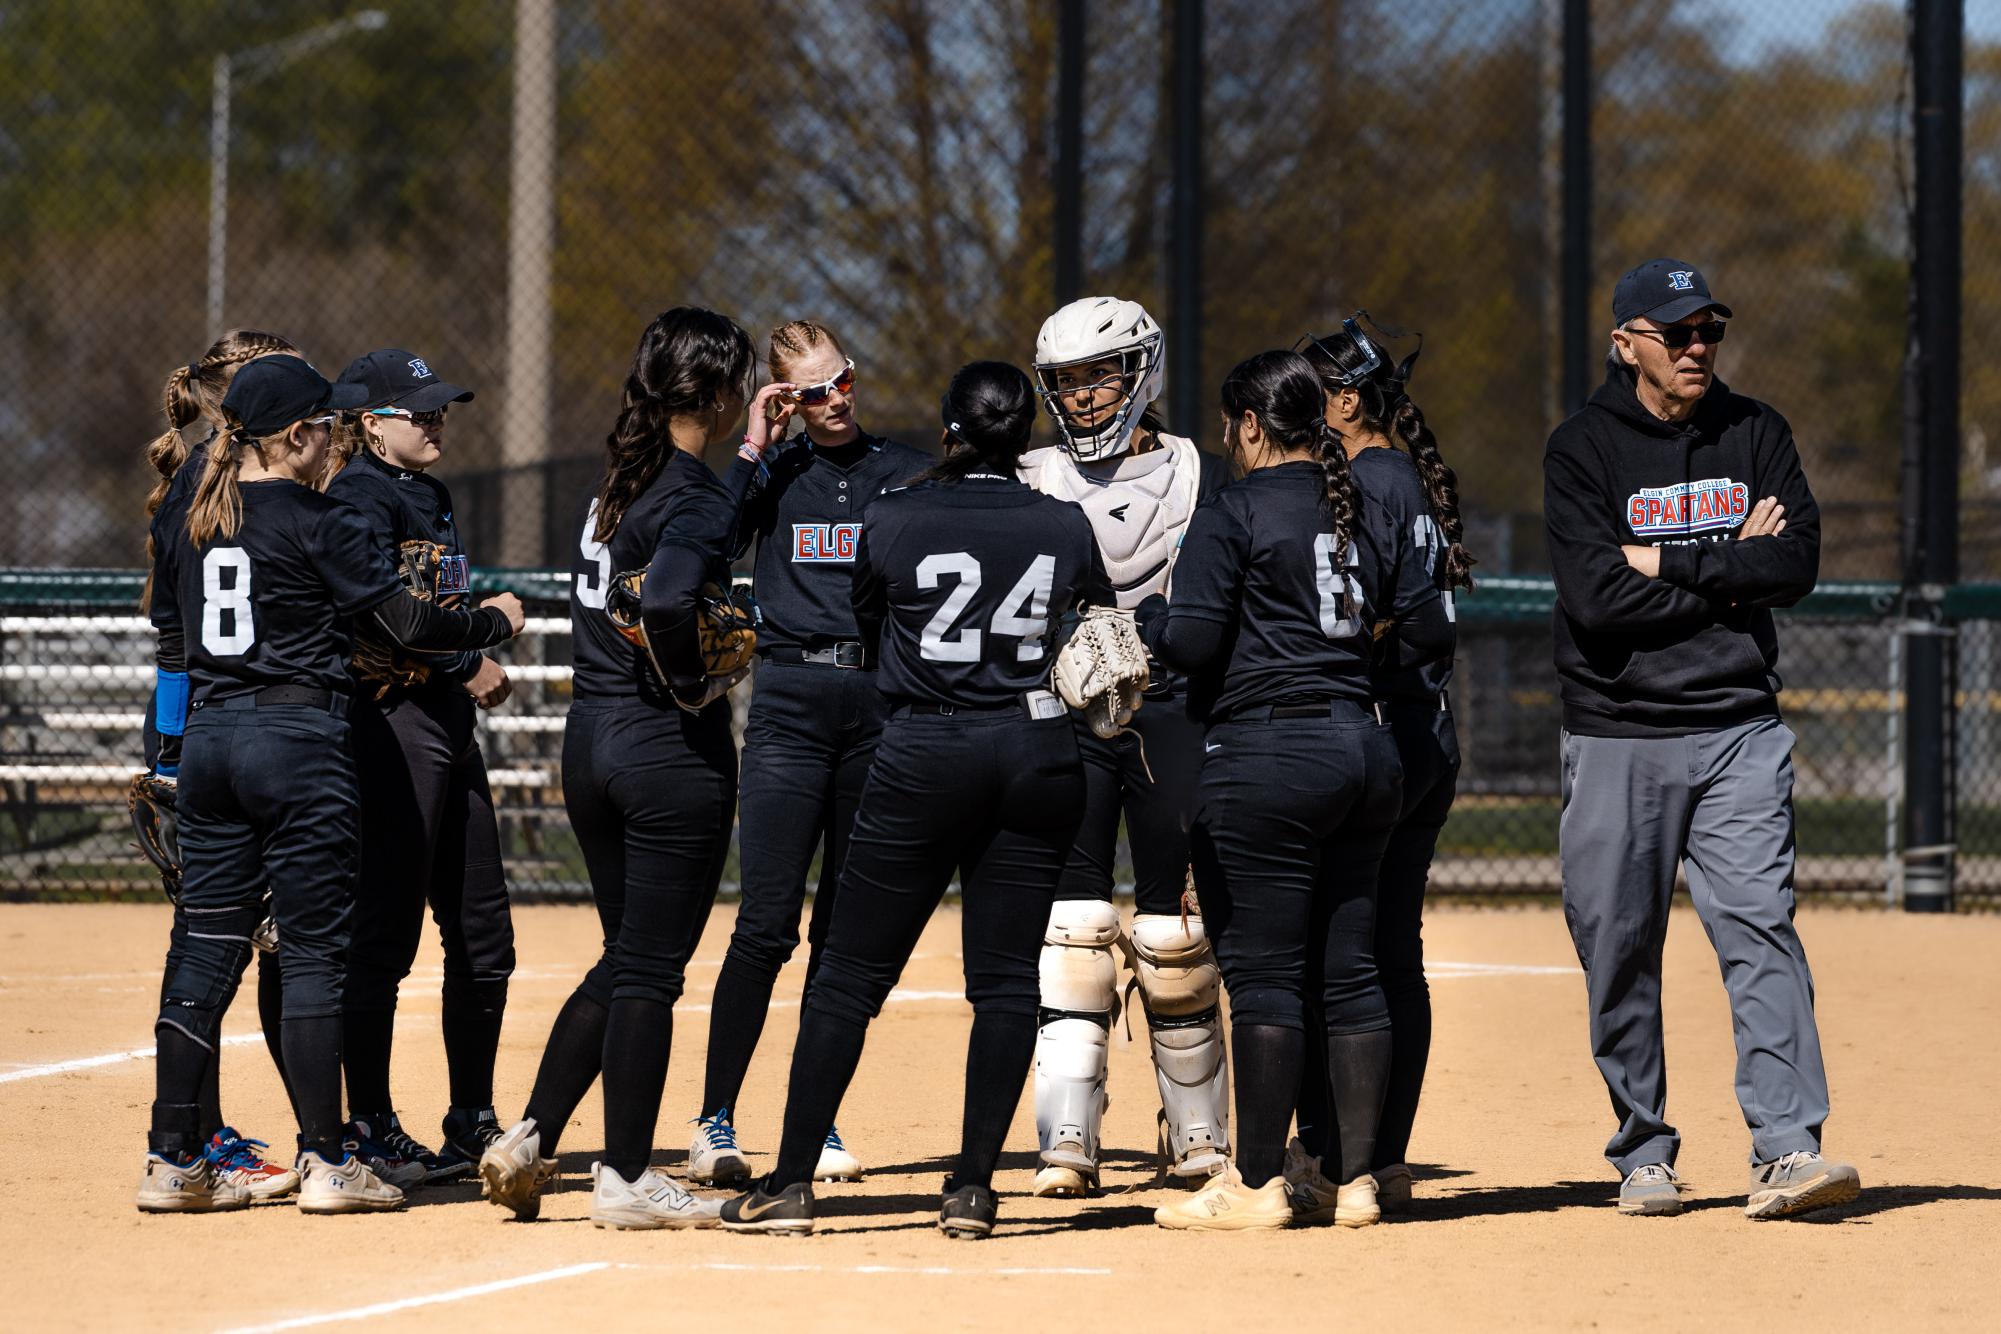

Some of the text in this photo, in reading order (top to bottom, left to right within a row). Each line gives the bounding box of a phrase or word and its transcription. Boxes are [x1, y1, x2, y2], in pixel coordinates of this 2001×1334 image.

[1668, 271, 1694, 290] E
[1642, 489, 1663, 497] ELGIN
[1697, 480, 1728, 489] COLLEGE
[791, 523, 863, 562] ELG
[202, 547, 255, 656] 8
[916, 552, 1056, 662] 24
[478, 1109, 495, 1122] NIK
